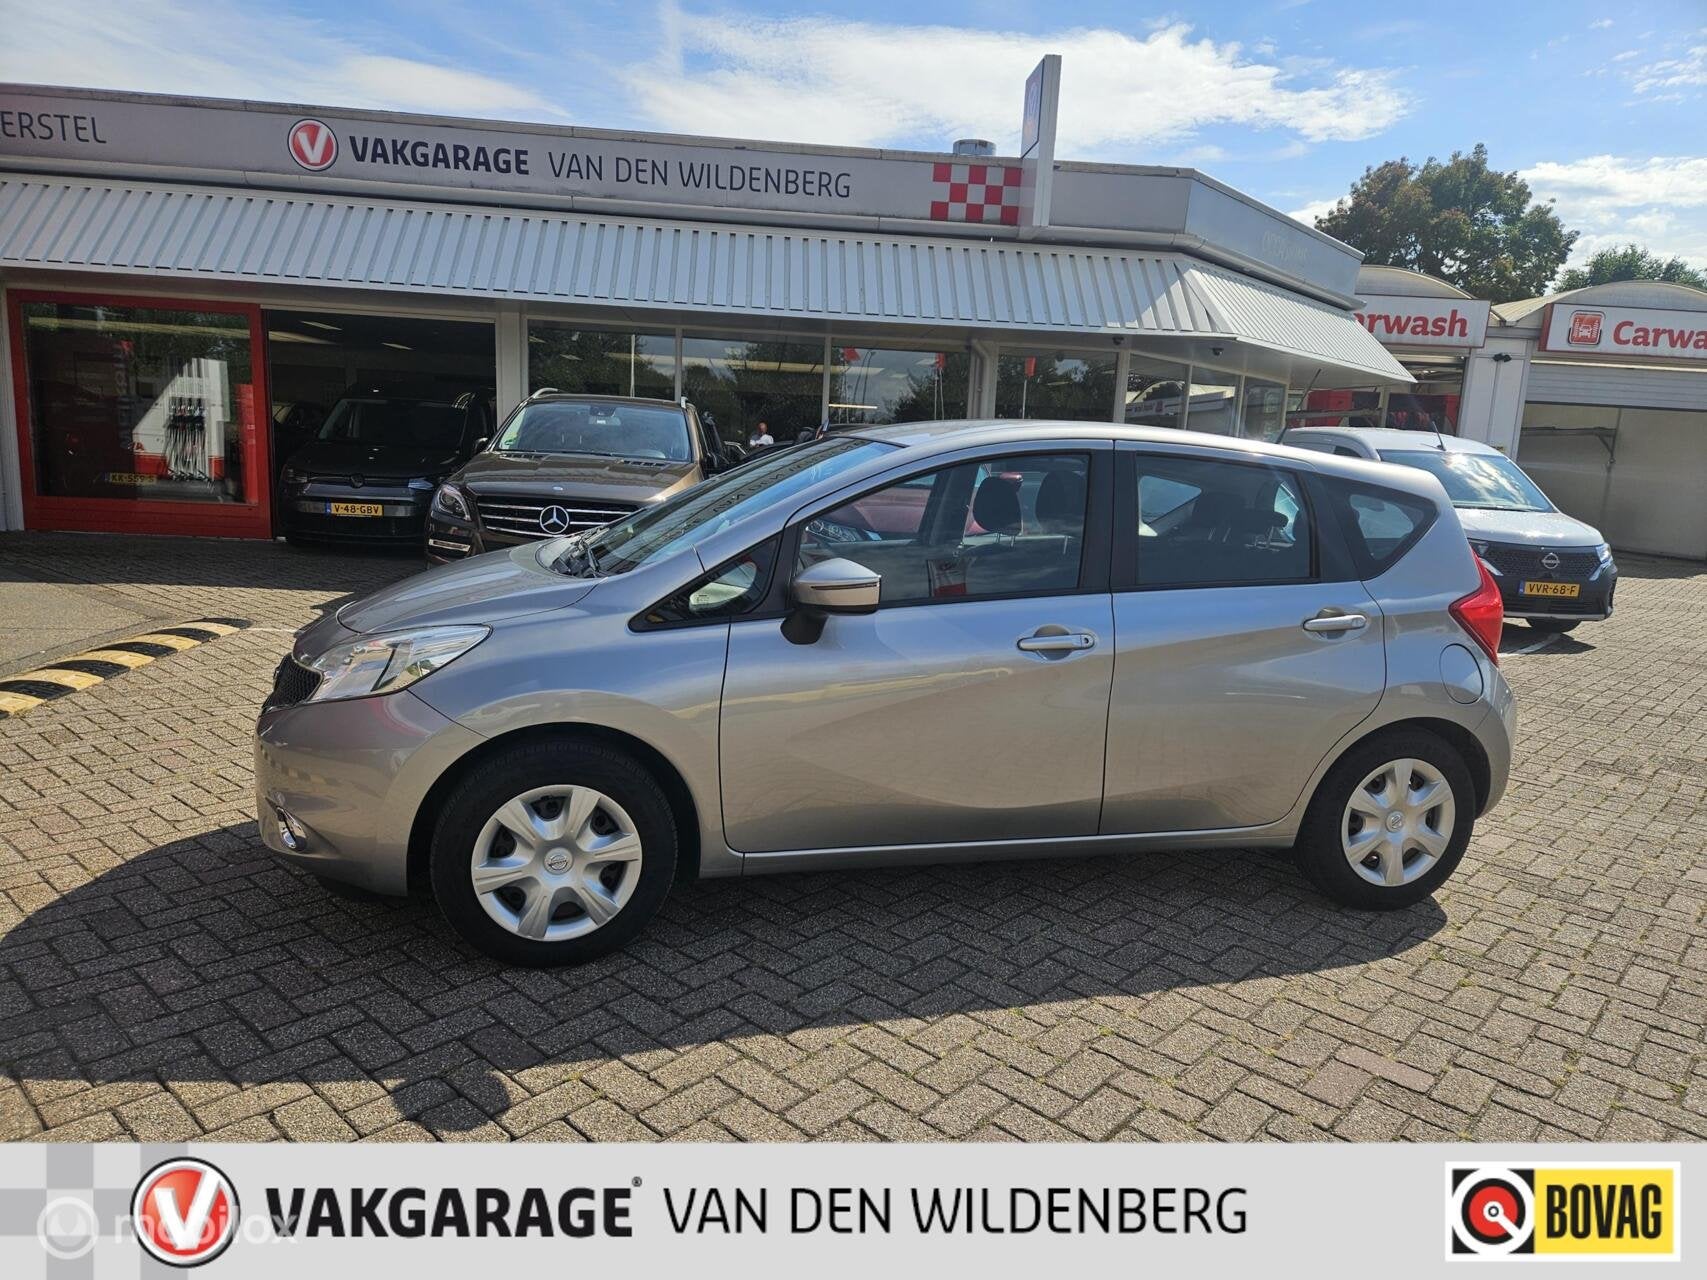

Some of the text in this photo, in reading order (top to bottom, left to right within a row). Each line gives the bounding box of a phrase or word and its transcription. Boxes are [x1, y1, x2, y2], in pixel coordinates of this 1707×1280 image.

[0, 110, 107, 144] ERSTEL
[350, 135, 851, 198] VAKGARAGE VAN DEN WILDENBERG
[334, 504, 379, 514] V-48-GBV
[1529, 583, 1577, 595] VVR-68-F
